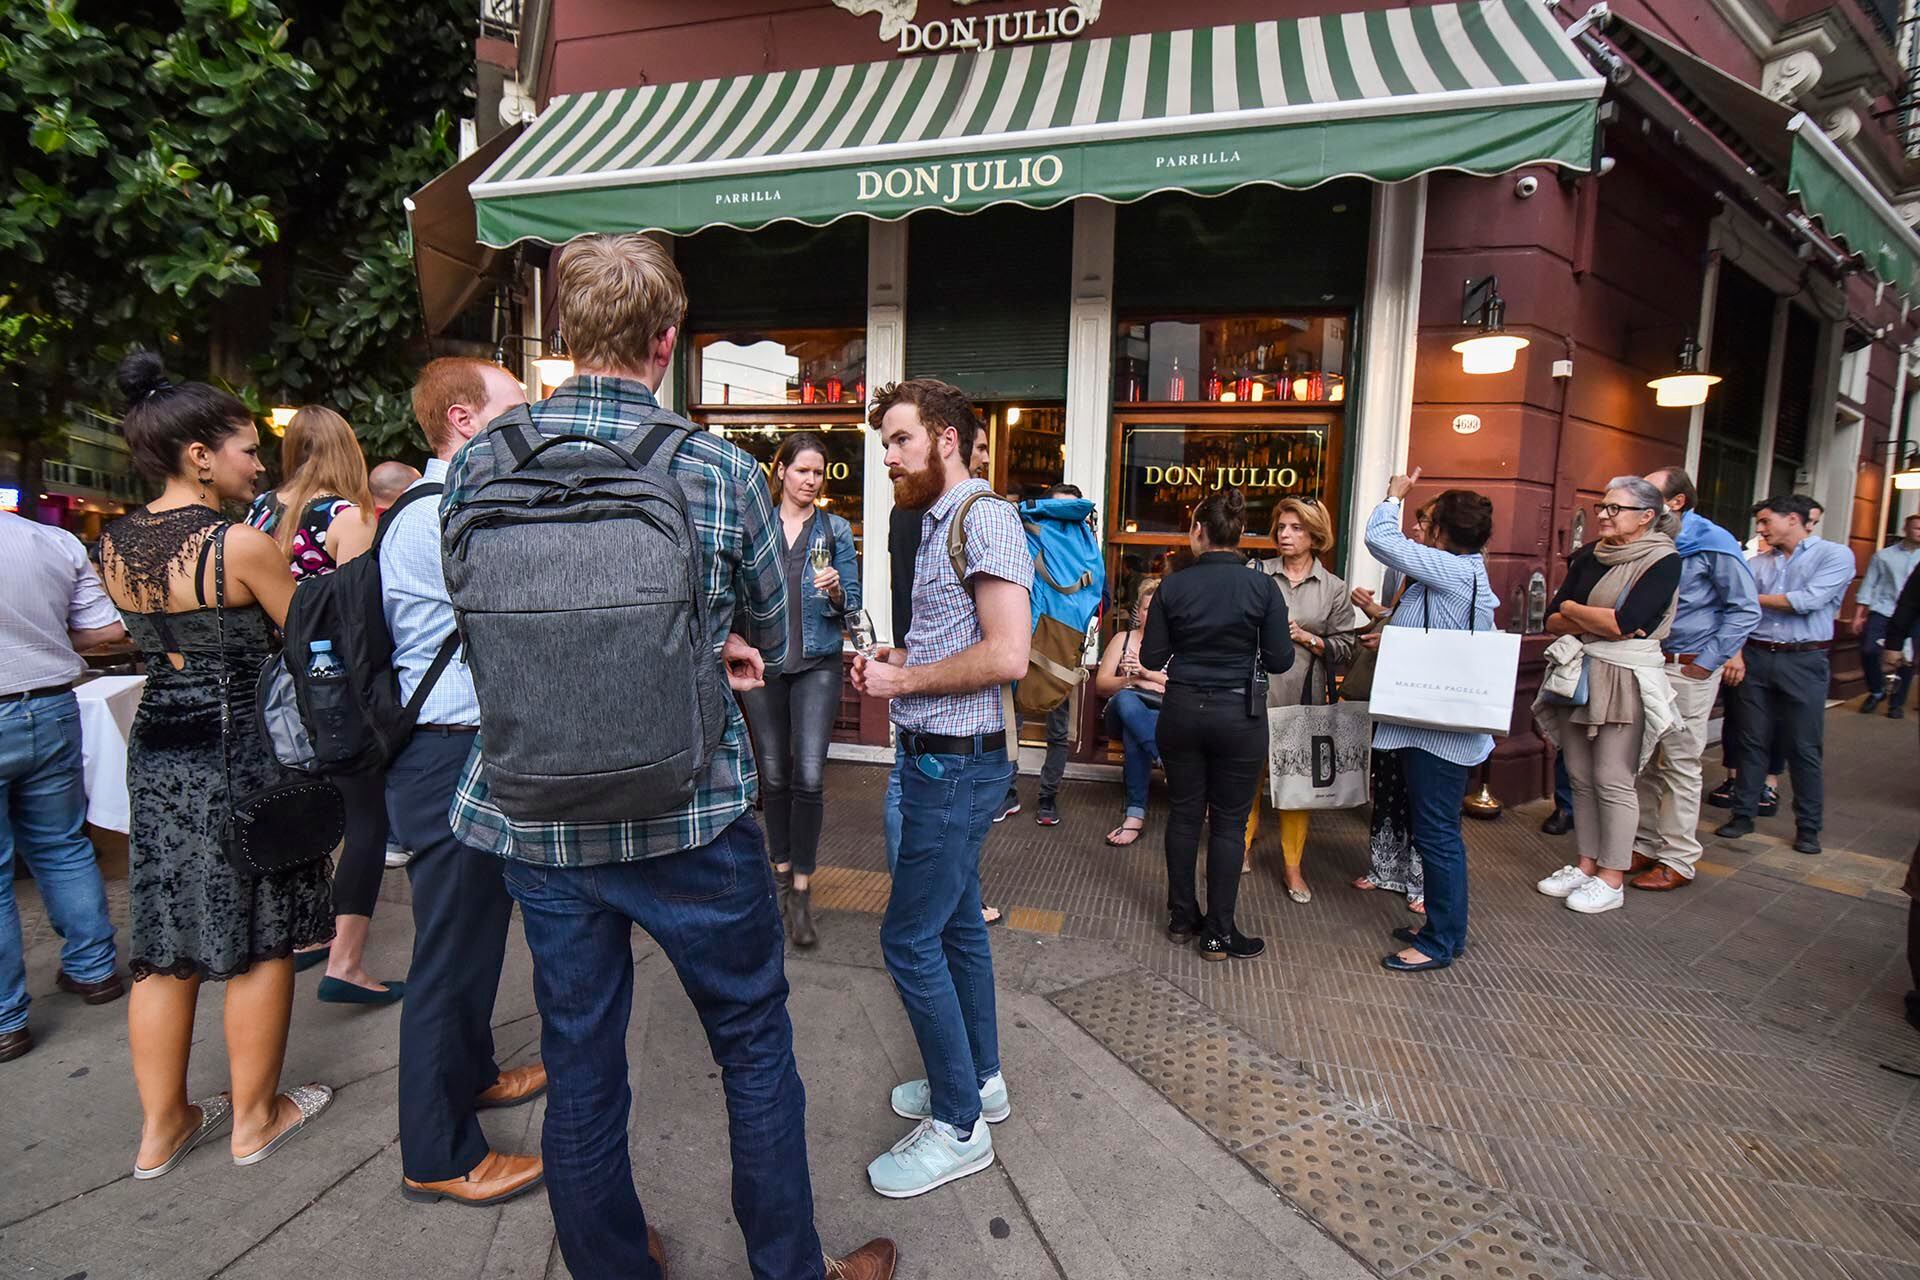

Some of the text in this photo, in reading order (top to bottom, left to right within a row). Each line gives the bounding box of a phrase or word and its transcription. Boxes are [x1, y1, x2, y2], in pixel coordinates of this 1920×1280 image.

[897, 5, 1088, 53] DON JULIO
[1155, 151, 1241, 169] PARRILLA
[856, 154, 1064, 204] DON JULIO
[715, 190, 782, 205] PARRILLA
[1144, 465, 1298, 491] DON JULIO
[1395, 681, 1441, 690] MARCELA
[1311, 735, 1335, 787] D
